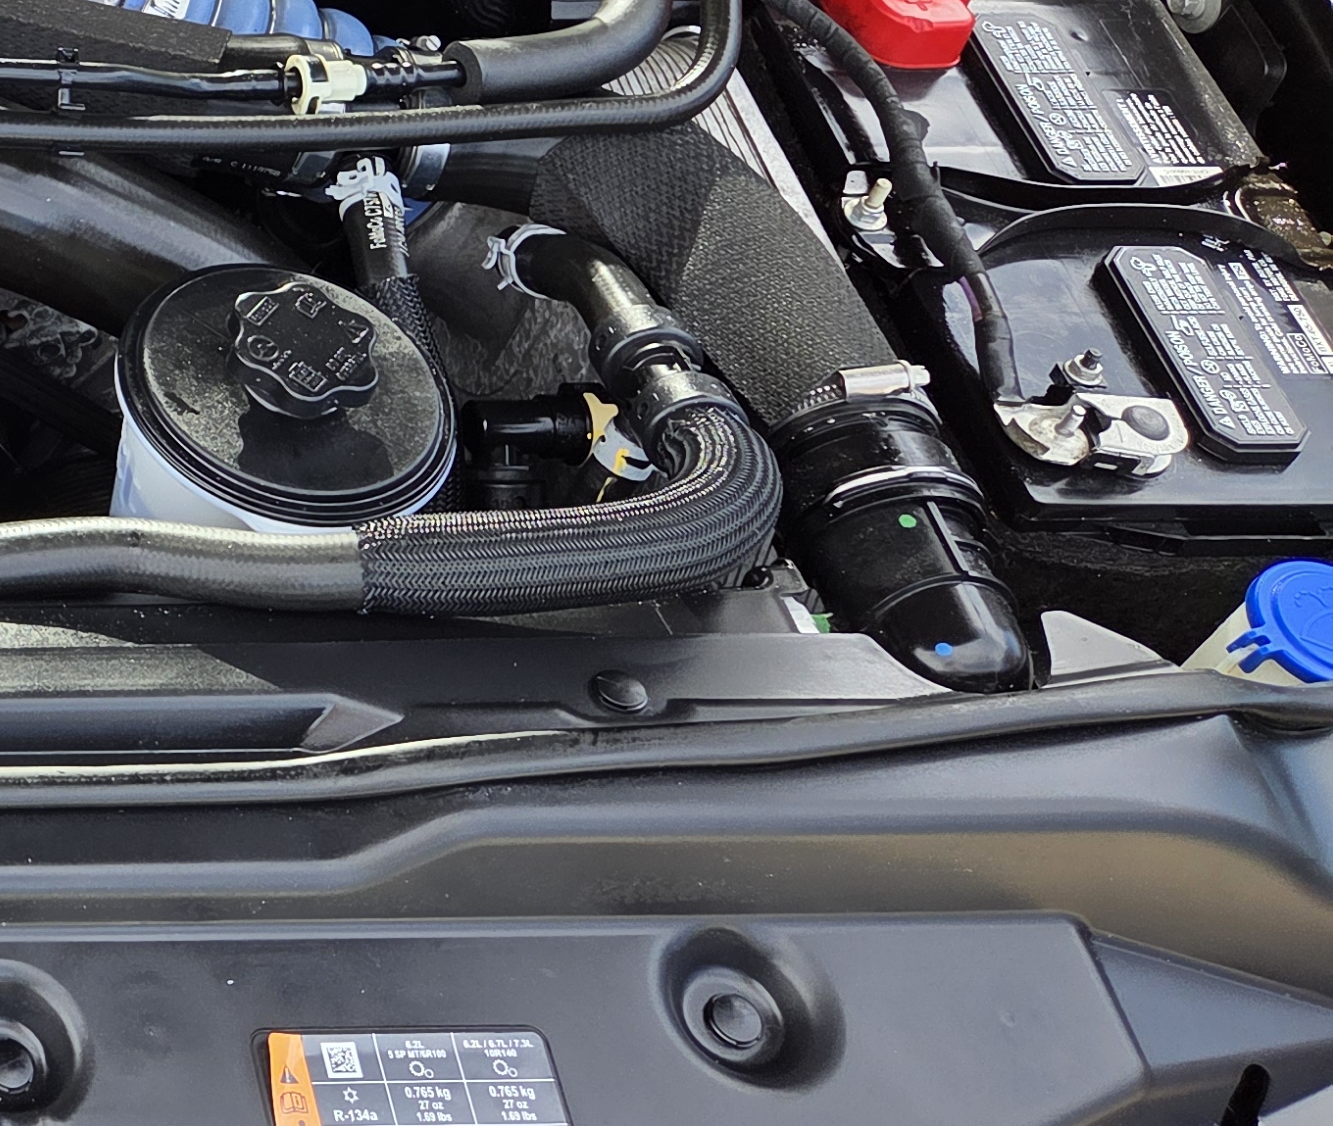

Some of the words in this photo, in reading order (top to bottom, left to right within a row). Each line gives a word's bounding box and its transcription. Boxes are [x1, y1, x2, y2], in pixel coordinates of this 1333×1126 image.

[1162, 330, 1200, 365] POISON
[1290, 334, 1325, 372] FoMoCo
[1189, 375, 1228, 414] DANGER
[405, 1040, 424, 1049] 6.2L
[463, 1039, 483, 1049] 6.2L
[404, 1086, 435, 1099] 0.765
[437, 1086, 452, 1101] kg
[489, 1085, 519, 1099] 0.765
[520, 1085, 535, 1101] kg
[418, 1100, 430, 1110] 27
[431, 1102, 444, 1110] oz
[502, 1100, 514, 1110] 27
[515, 1102, 529, 1110] oz
[333, 1109, 379, 1122] R-134a
[416, 1111, 435, 1122] 1.69
[437, 1111, 452, 1122] lbs
[501, 1111, 521, 1122] 1.69
[522, 1111, 537, 1122] lbs
